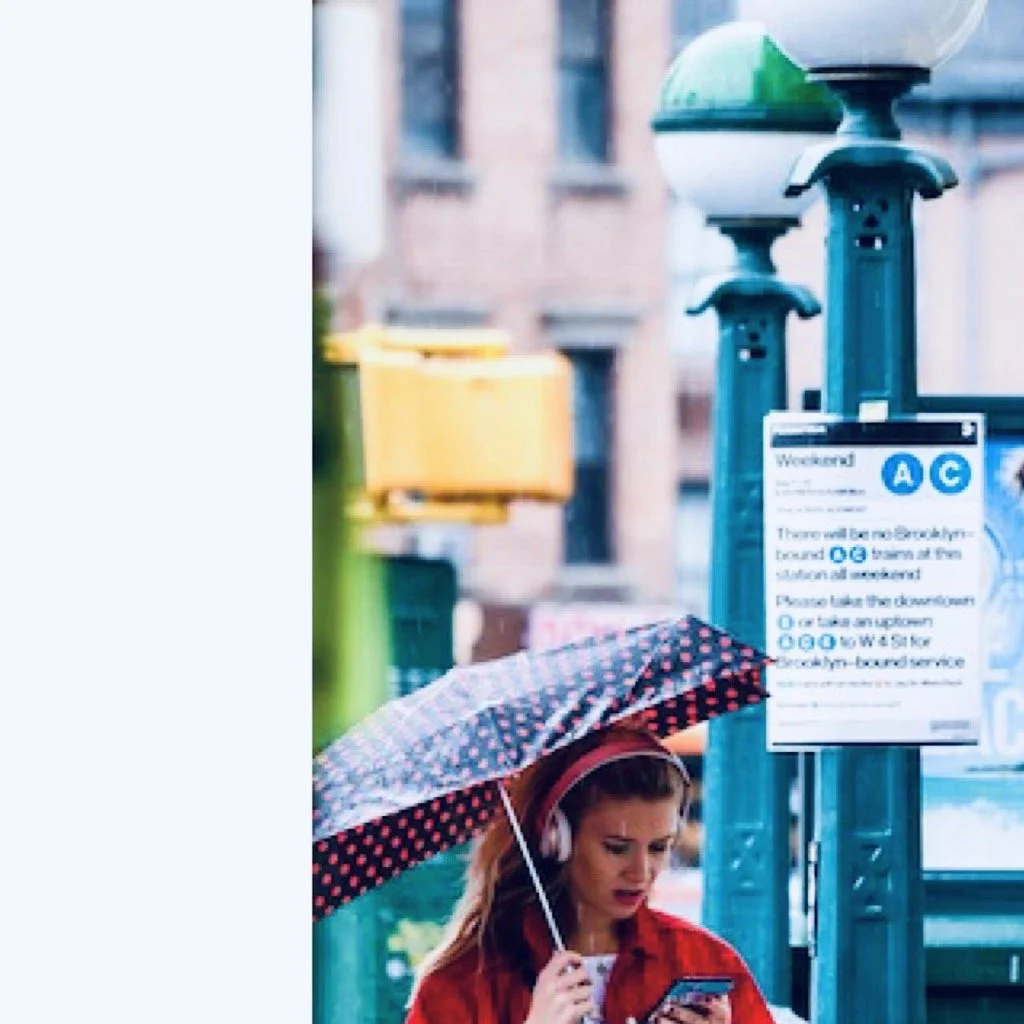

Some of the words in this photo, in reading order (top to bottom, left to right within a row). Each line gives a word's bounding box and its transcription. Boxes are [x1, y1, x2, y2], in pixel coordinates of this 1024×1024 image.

[775, 453, 857, 468] Weekend
[777, 527, 820, 540] There
[824, 527, 847, 540] will
[850, 527, 869, 540] be
[872, 529, 891, 540] no
[776, 547, 825, 560] bound
[872, 548, 914, 560] trains
[917, 548, 930, 560] at
[935, 548, 962, 560] this
[776, 568, 827, 580] station
[830, 568, 847, 580] all
[850, 568, 921, 580] weekend
[776, 595, 827, 608] Please
[830, 595, 862, 608] take
[866, 595, 891, 608] the
[894, 595, 975, 608] downtown
[798, 618, 814, 627] or
[818, 616, 849, 628] take
[853, 618, 872, 628] an
[875, 616, 933, 629] uptown
[840, 636, 856, 647] to
[859, 636, 874, 647] W
[878, 636, 888, 647] 4
[891, 636, 907, 647] St
[910, 635, 931, 647] for
[910, 655, 965, 669] service
